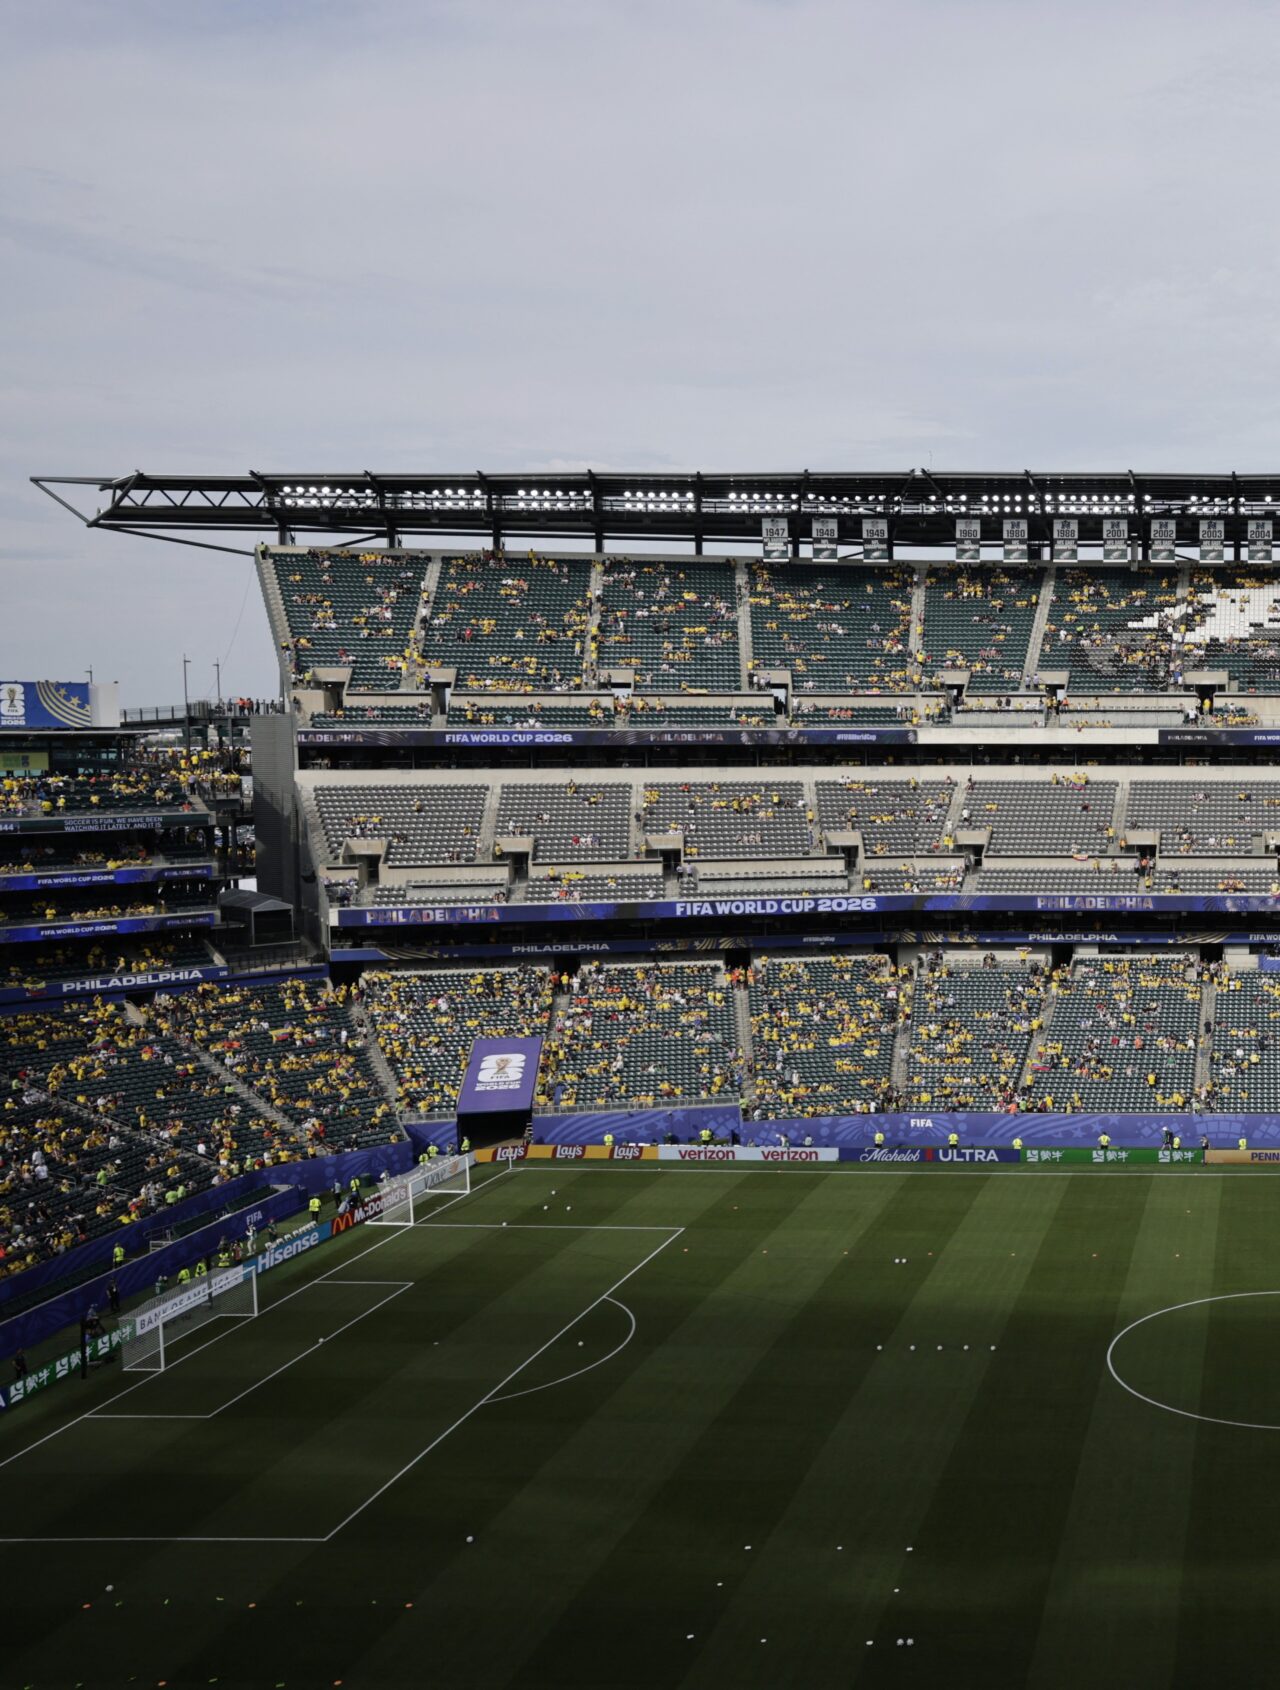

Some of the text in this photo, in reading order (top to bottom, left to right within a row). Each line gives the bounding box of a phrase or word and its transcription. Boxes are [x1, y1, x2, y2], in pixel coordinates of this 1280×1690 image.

[765, 528, 785, 537] 1947
[815, 528, 835, 537] 1948
[866, 529, 885, 538] 1949
[960, 529, 978, 538] 1960
[1006, 529, 1025, 538] 1980
[1057, 529, 1076, 538] 1988
[1106, 529, 1125, 538] 2001
[1153, 529, 1174, 538] 2002
[1201, 530, 1222, 538] 2003
[1250, 530, 1271, 539] 2004
[445, 734, 573, 743] FIFA WORLD CUP 2026
[650, 733, 724, 742] PHILADELPHIA
[676, 898, 878, 916] FIFA WORLD CUP 2026
[1037, 897, 1154, 910] PHILADELPHIA
[366, 908, 500, 923] PHILADELPHIA
[40, 924, 118, 936] FIFA WORLD CUP 2026
[1028, 933, 1118, 941] PHILADELPHIA
[512, 943, 610, 953] PHILADELPHIA
[62, 969, 203, 992] PHILADELPHIA
[910, 1119, 933, 1128] FIFA
[556, 1144, 583, 1159] Lay's
[613, 1145, 640, 1160] Lay's
[678, 1148, 736, 1161] verizon
[761, 1149, 819, 1161] verizon
[860, 1148, 999, 1162] Michelob ULTRA
[246, 1210, 263, 1226] FIFA
[257, 1231, 320, 1273] Hisense
